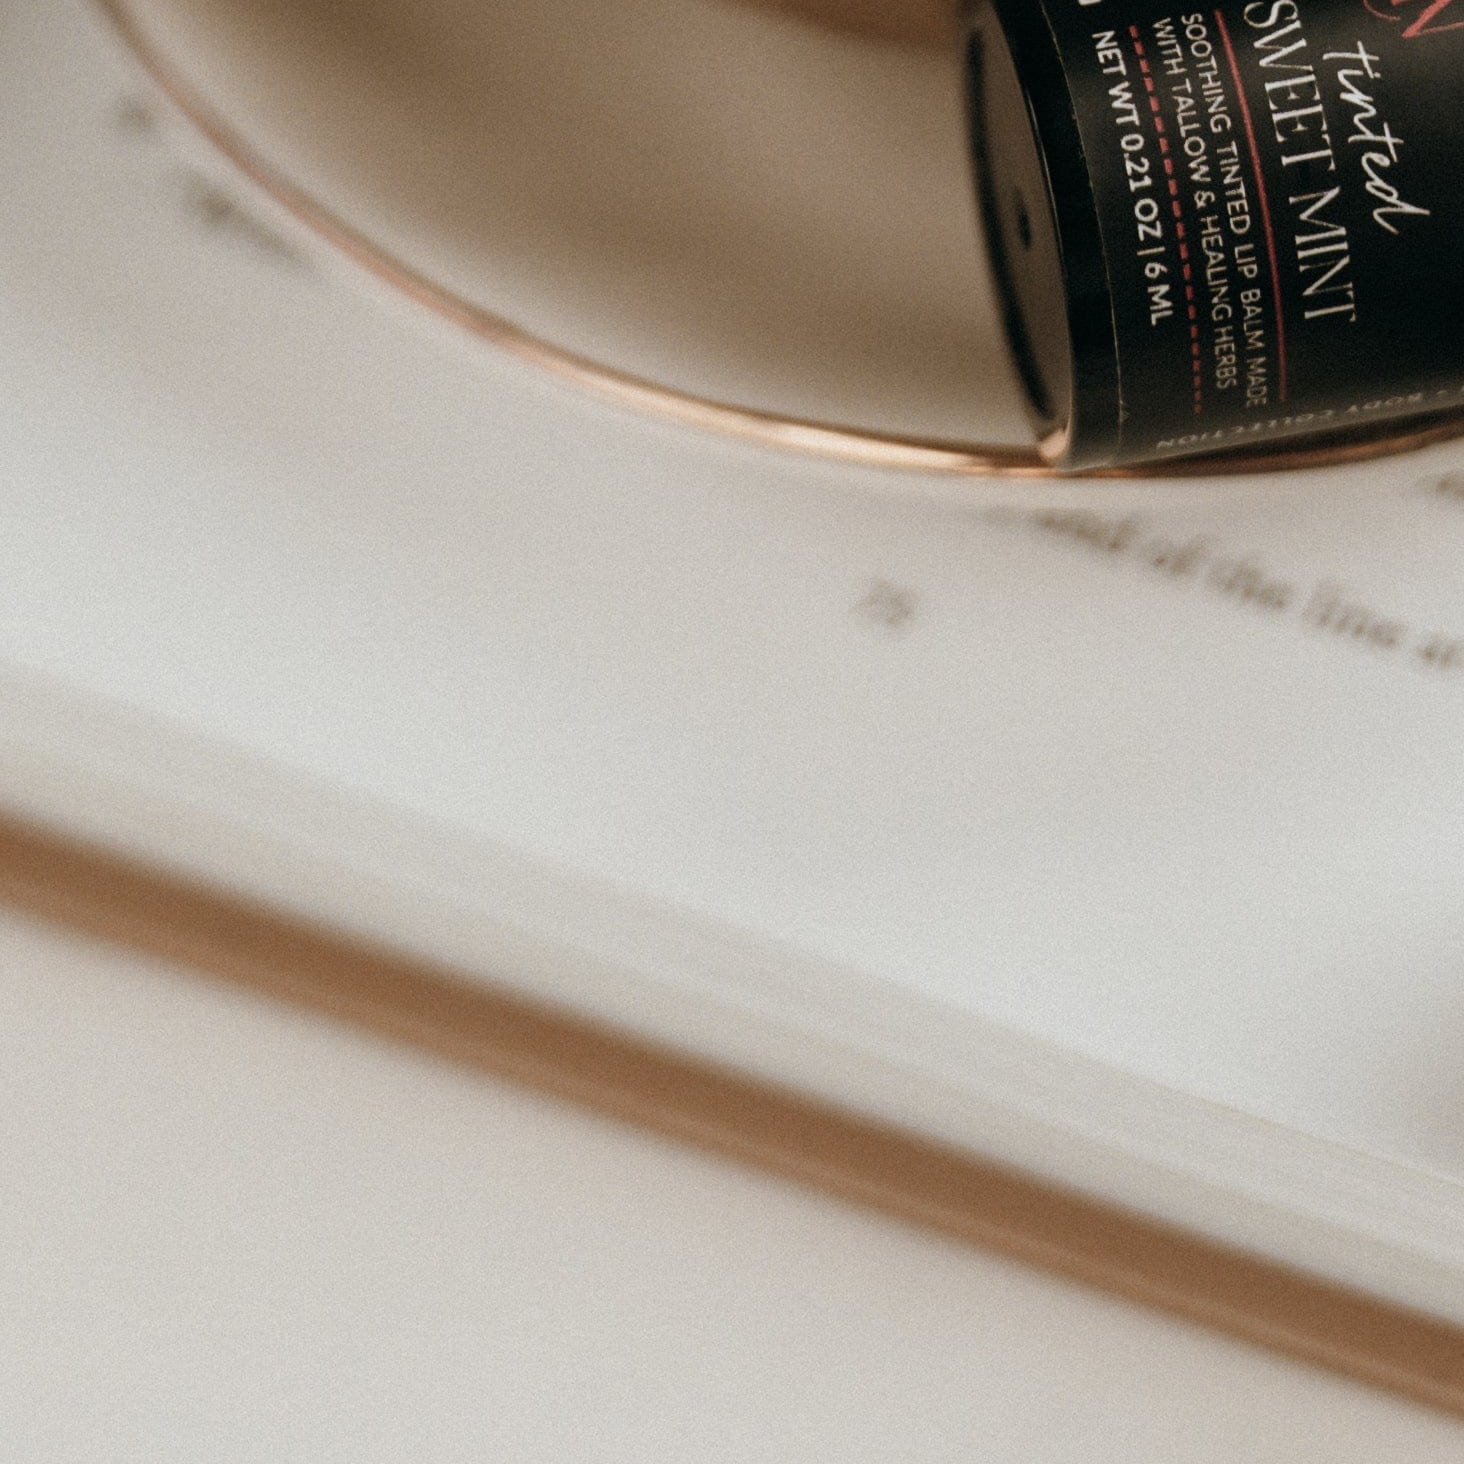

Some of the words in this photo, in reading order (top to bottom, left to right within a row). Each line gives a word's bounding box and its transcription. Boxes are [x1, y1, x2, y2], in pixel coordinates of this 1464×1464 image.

[1091, 30, 1127, 77] NET
[1152, 17, 1188, 76] WITH
[1180, 12, 1232, 133] SOOTHING
[1107, 81, 1141, 127] WT
[1171, 77, 1212, 183] TALLOW
[1120, 133, 1153, 193] 0.21
[1322, 40, 1431, 236] tinted
[1193, 189, 1216, 210] &
[1216, 139, 1251, 235] TINTED
[1134, 197, 1163, 242] OZ
[1144, 261, 1168, 279] 6
[1200, 213, 1233, 322] HEALING
[1234, 243, 1258, 279] LIP
[1288, 186, 1357, 322] MINT
[1147, 283, 1174, 327] ML
[1240, 287, 1266, 350] BALM
[1214, 325, 1238, 390] HERBS
[1246, 355, 1268, 407] MADE
